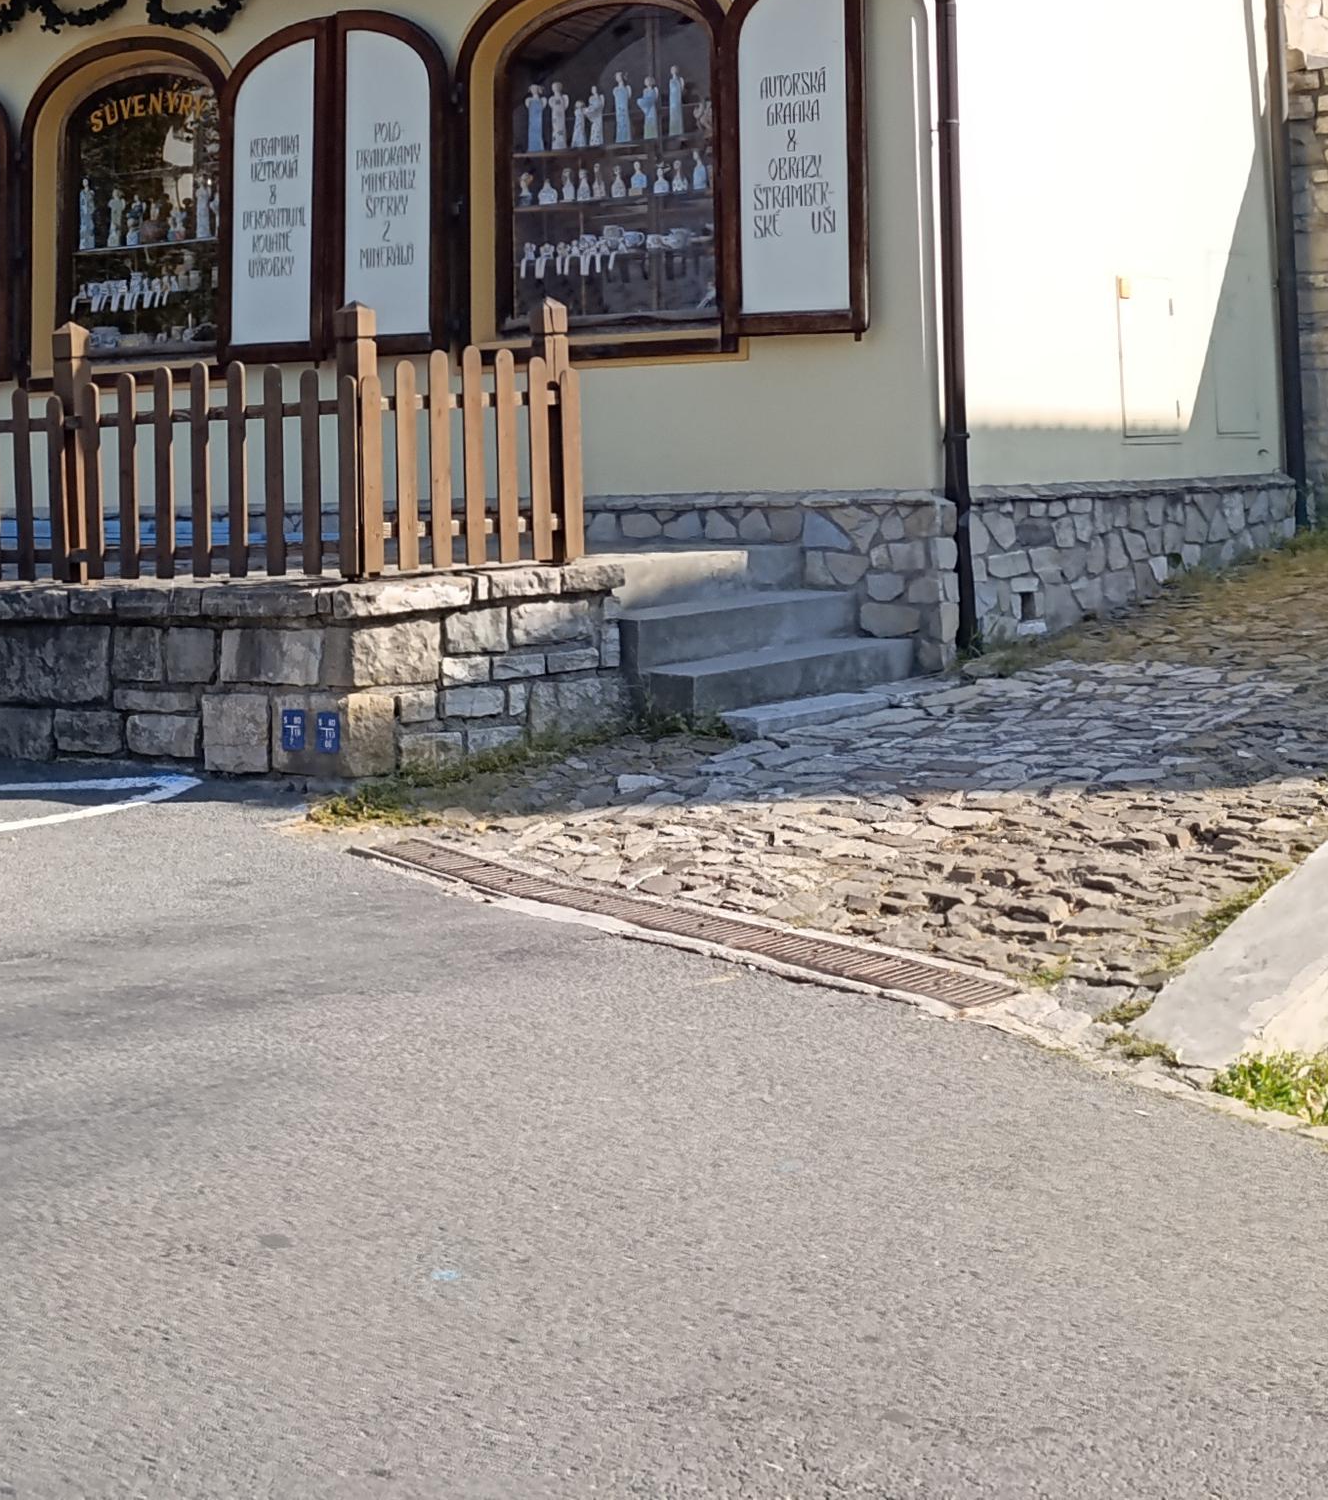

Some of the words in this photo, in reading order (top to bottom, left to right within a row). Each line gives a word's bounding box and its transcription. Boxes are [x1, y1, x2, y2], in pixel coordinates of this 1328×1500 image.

[760, 67, 826, 100] AUTORSKÁ
[90, 80, 205, 132] SUVENÝRY
[766, 99, 820, 127] GRAFIKA
[250, 134, 300, 158] KERAMIKA
[365, 194, 409, 219] ŠPERKY
[753, 209, 783, 239] SKÉ
[811, 206, 836, 234] UŠI
